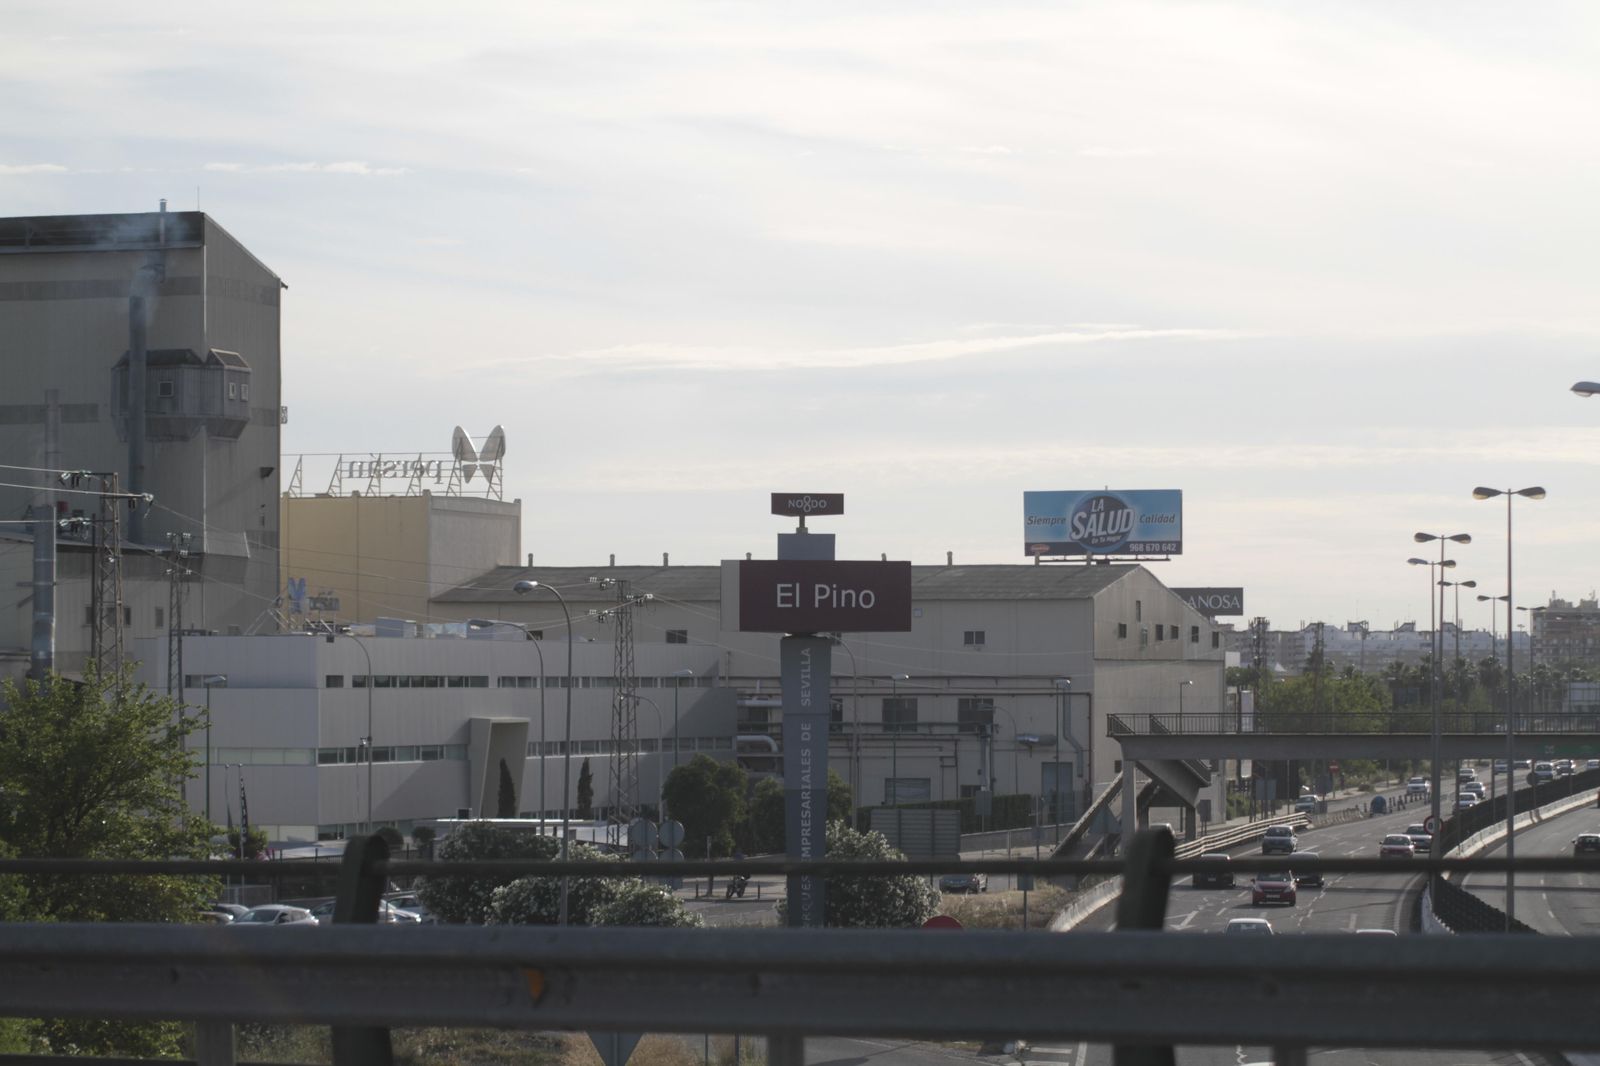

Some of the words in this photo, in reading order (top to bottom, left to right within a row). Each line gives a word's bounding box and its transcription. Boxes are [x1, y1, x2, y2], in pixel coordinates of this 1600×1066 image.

[1091, 498, 1104, 512] LA
[1027, 515, 1066, 527] Siempre
[1071, 508, 1135, 540] SALUD
[1140, 513, 1175, 524] Calidad
[1162, 543, 1176, 552] 642
[776, 582, 800, 608] El
[814, 583, 875, 609] Pino
[1189, 594, 1241, 609] ANOSA
[800, 647, 811, 706] SEVILLA
[801, 723, 811, 741] DE
